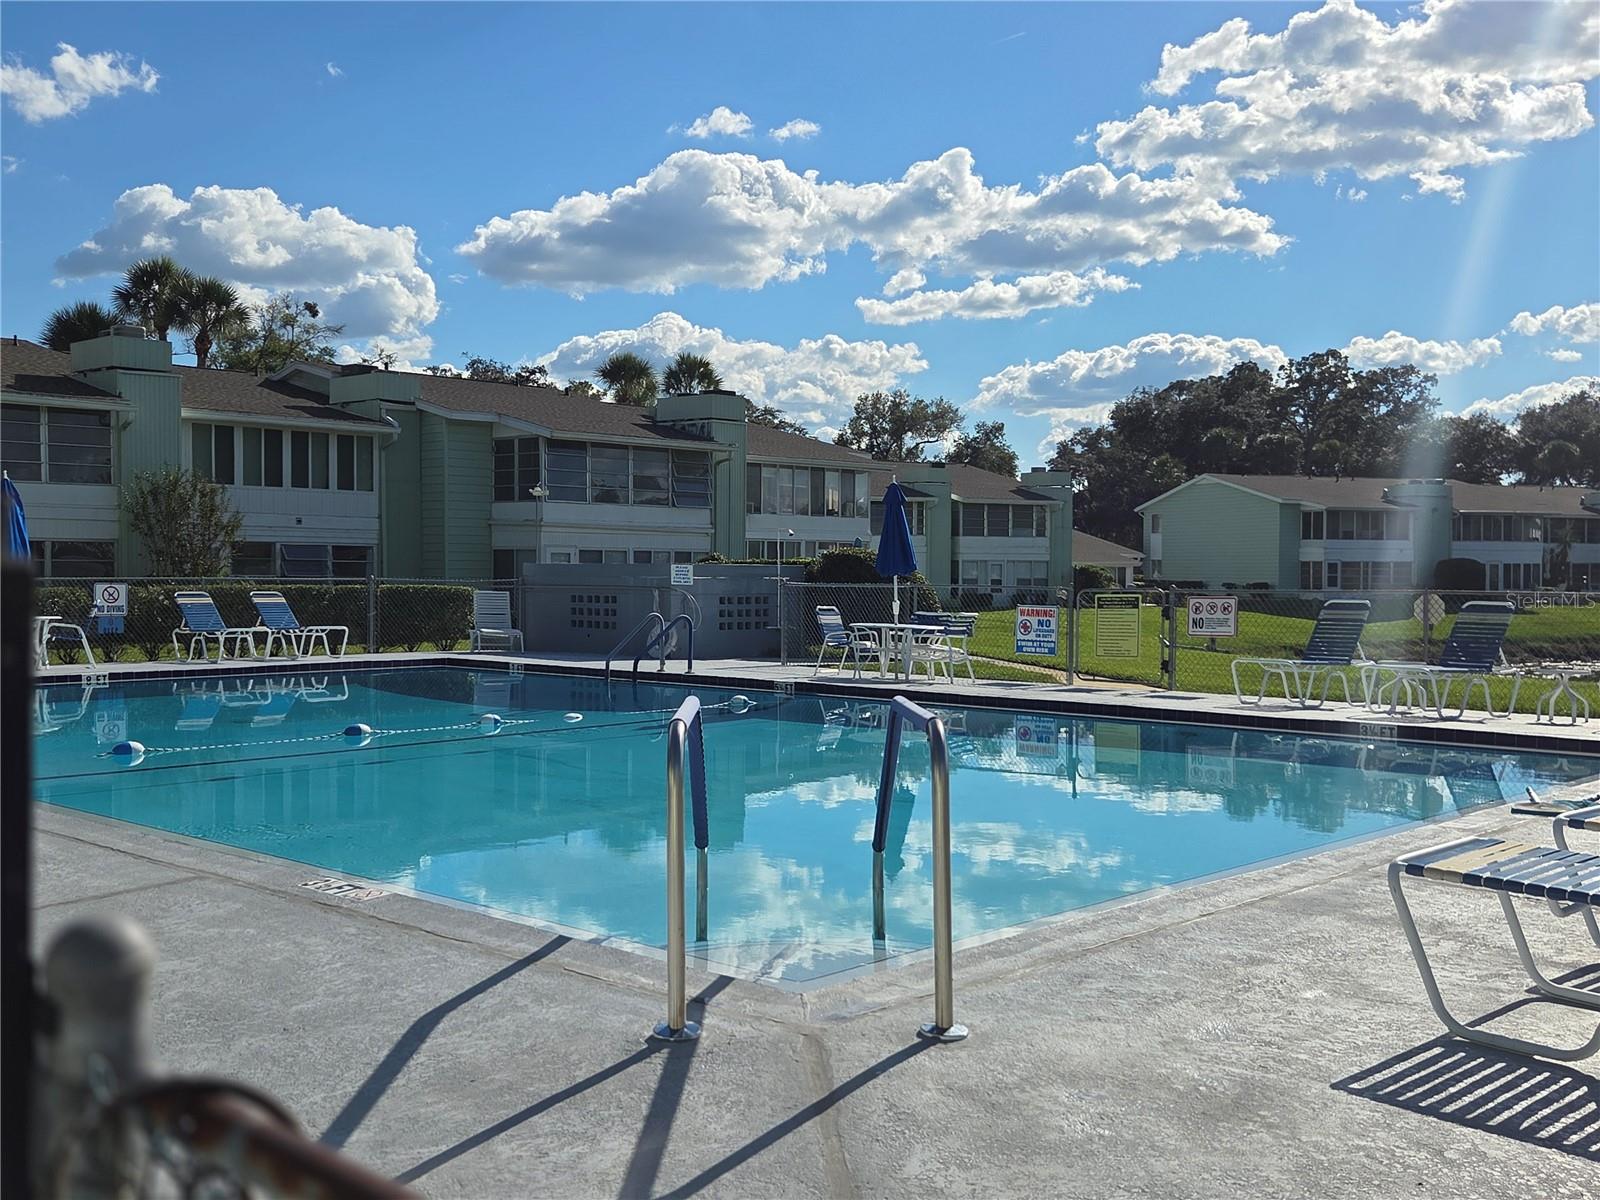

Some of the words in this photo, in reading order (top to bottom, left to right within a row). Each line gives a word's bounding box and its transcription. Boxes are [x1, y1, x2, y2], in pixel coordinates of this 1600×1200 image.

[107, 604, 125, 613] DIVING
[1020, 607, 1056, 618] WARNING!
[1037, 619, 1052, 628] NO
[1192, 617, 1204, 630] NO
[1380, 726, 1397, 738] FT
